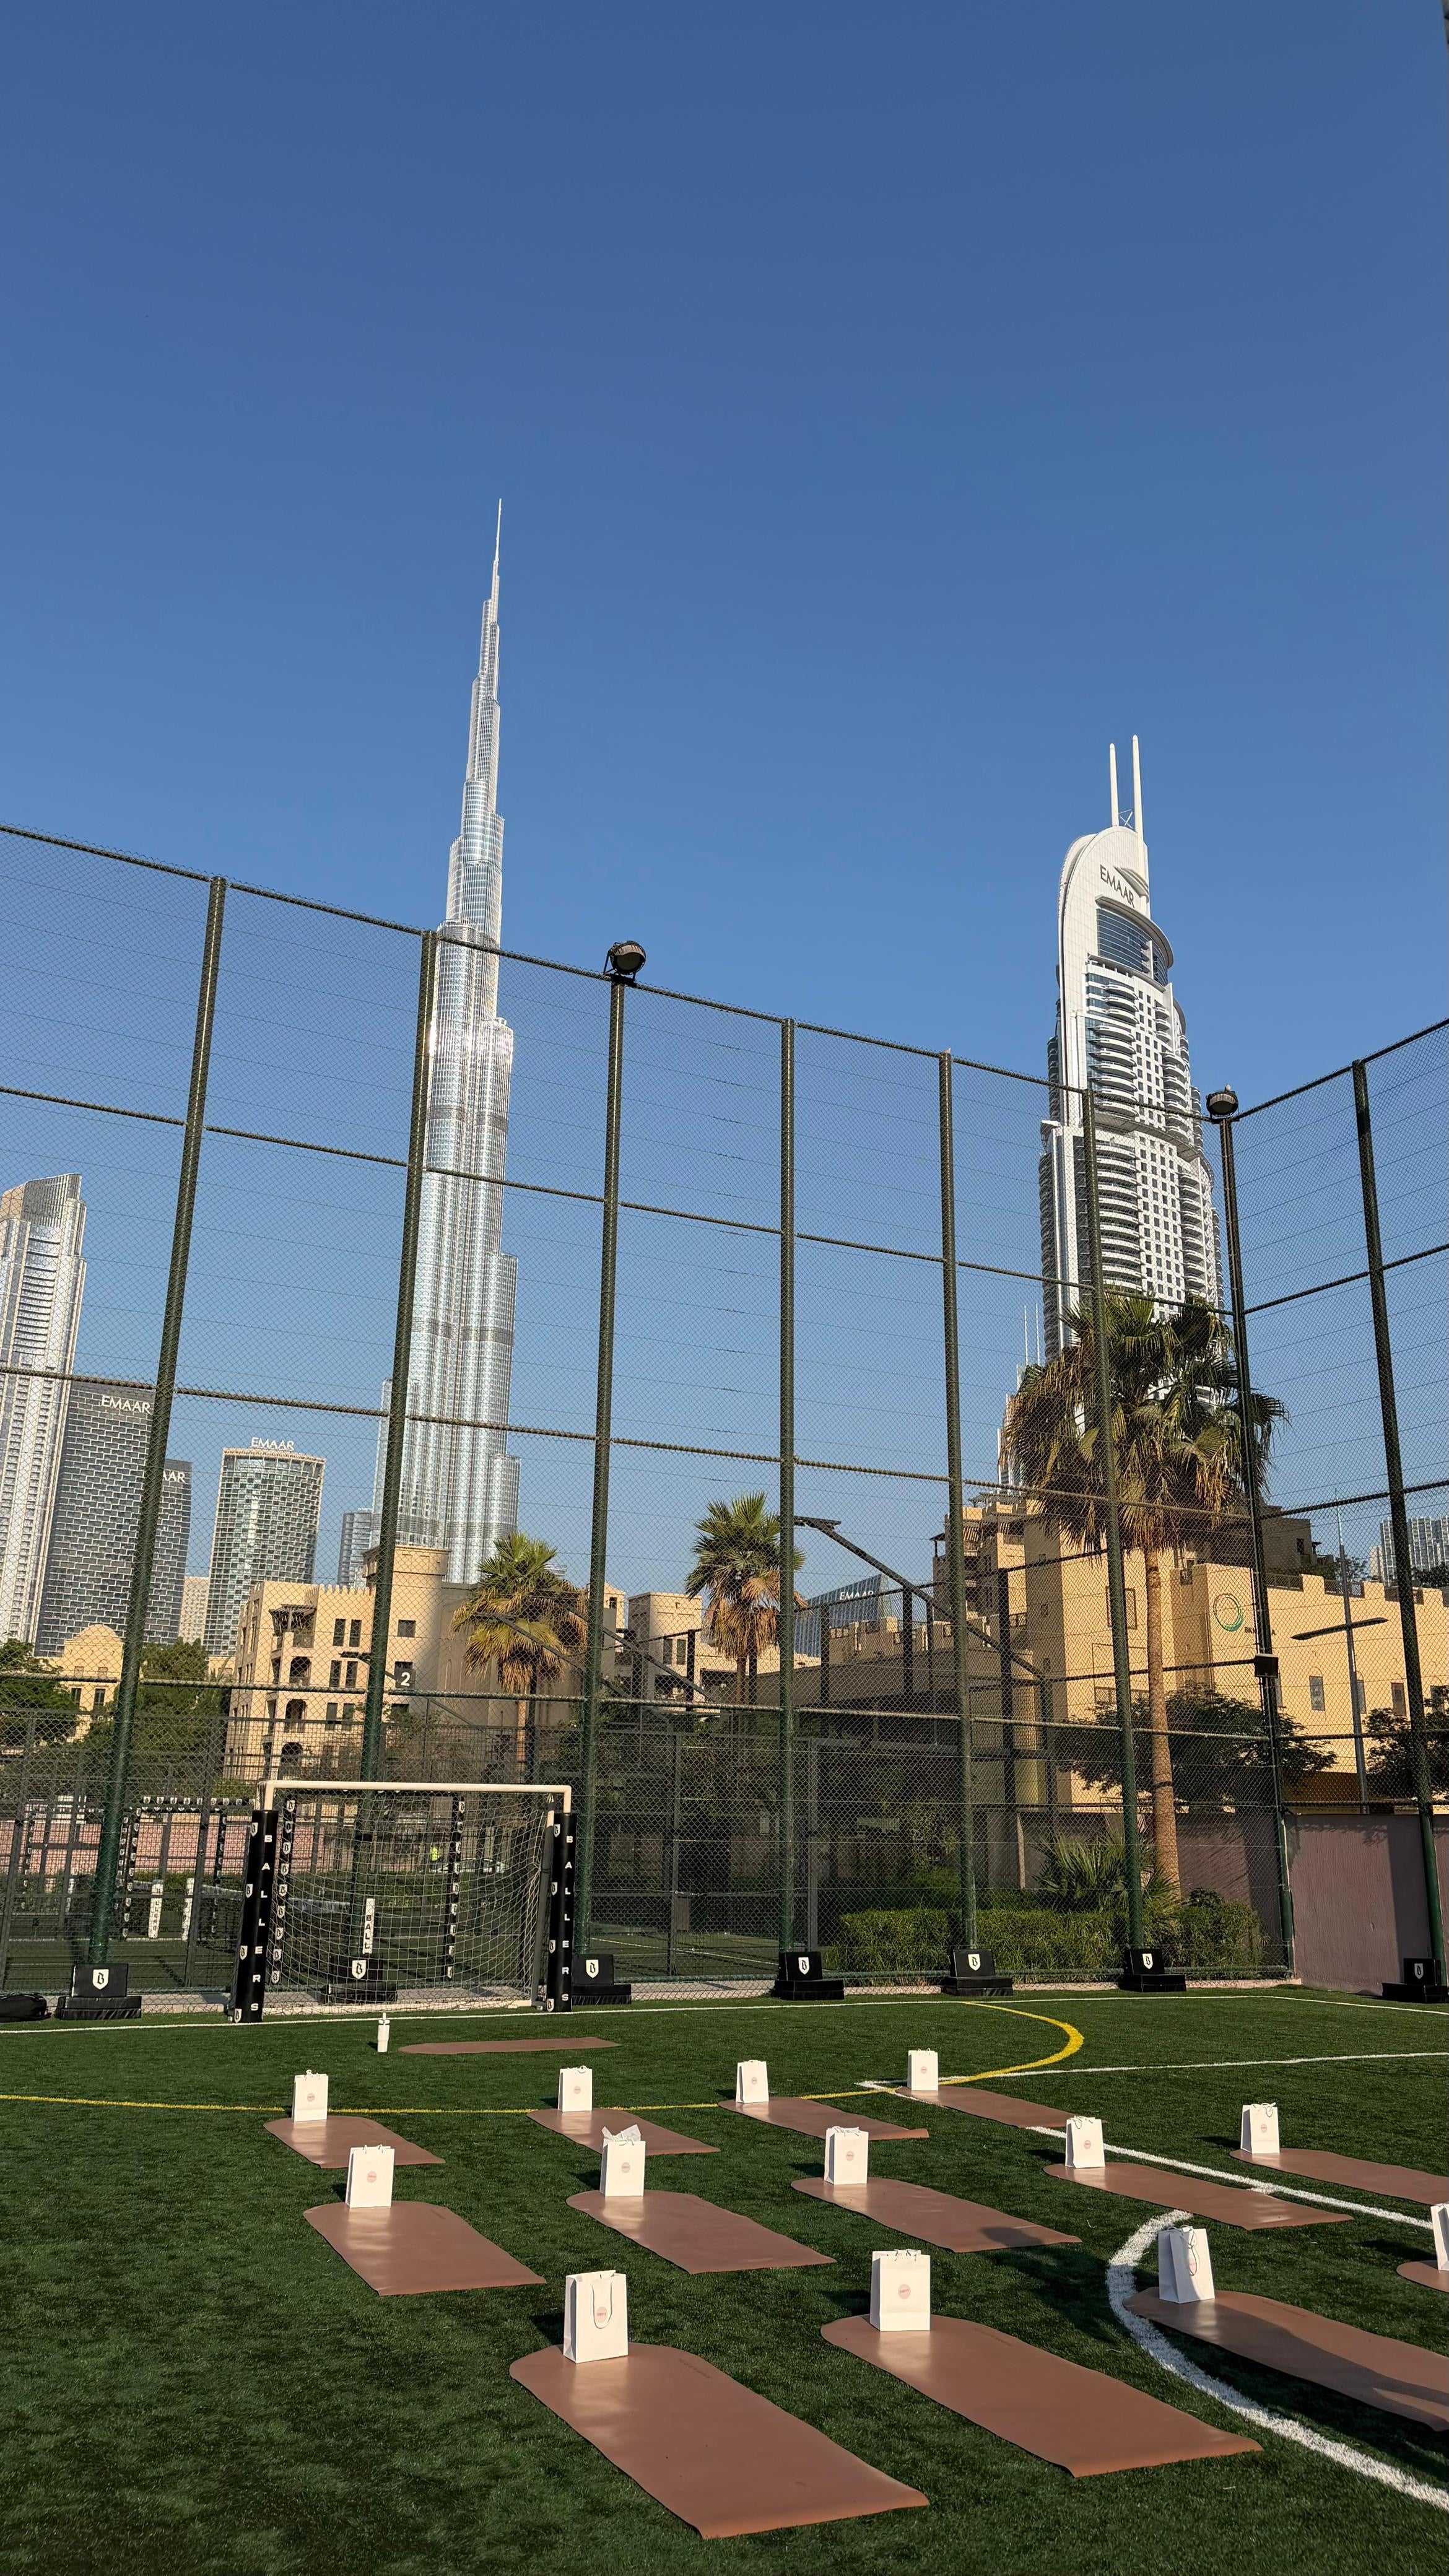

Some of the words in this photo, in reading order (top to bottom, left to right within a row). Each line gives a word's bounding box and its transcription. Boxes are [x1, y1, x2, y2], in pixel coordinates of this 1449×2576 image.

[1100, 864, 1135, 908] EMAAR
[102, 1395, 153, 1415] EMAAR
[251, 1437, 295, 1451] EMAAR
[163, 1470, 187, 1484] AAR
[401, 1672, 411, 1687] 2
[250, 1835, 272, 2011] BALLERS
[561, 1835, 573, 2001] BALLERS
